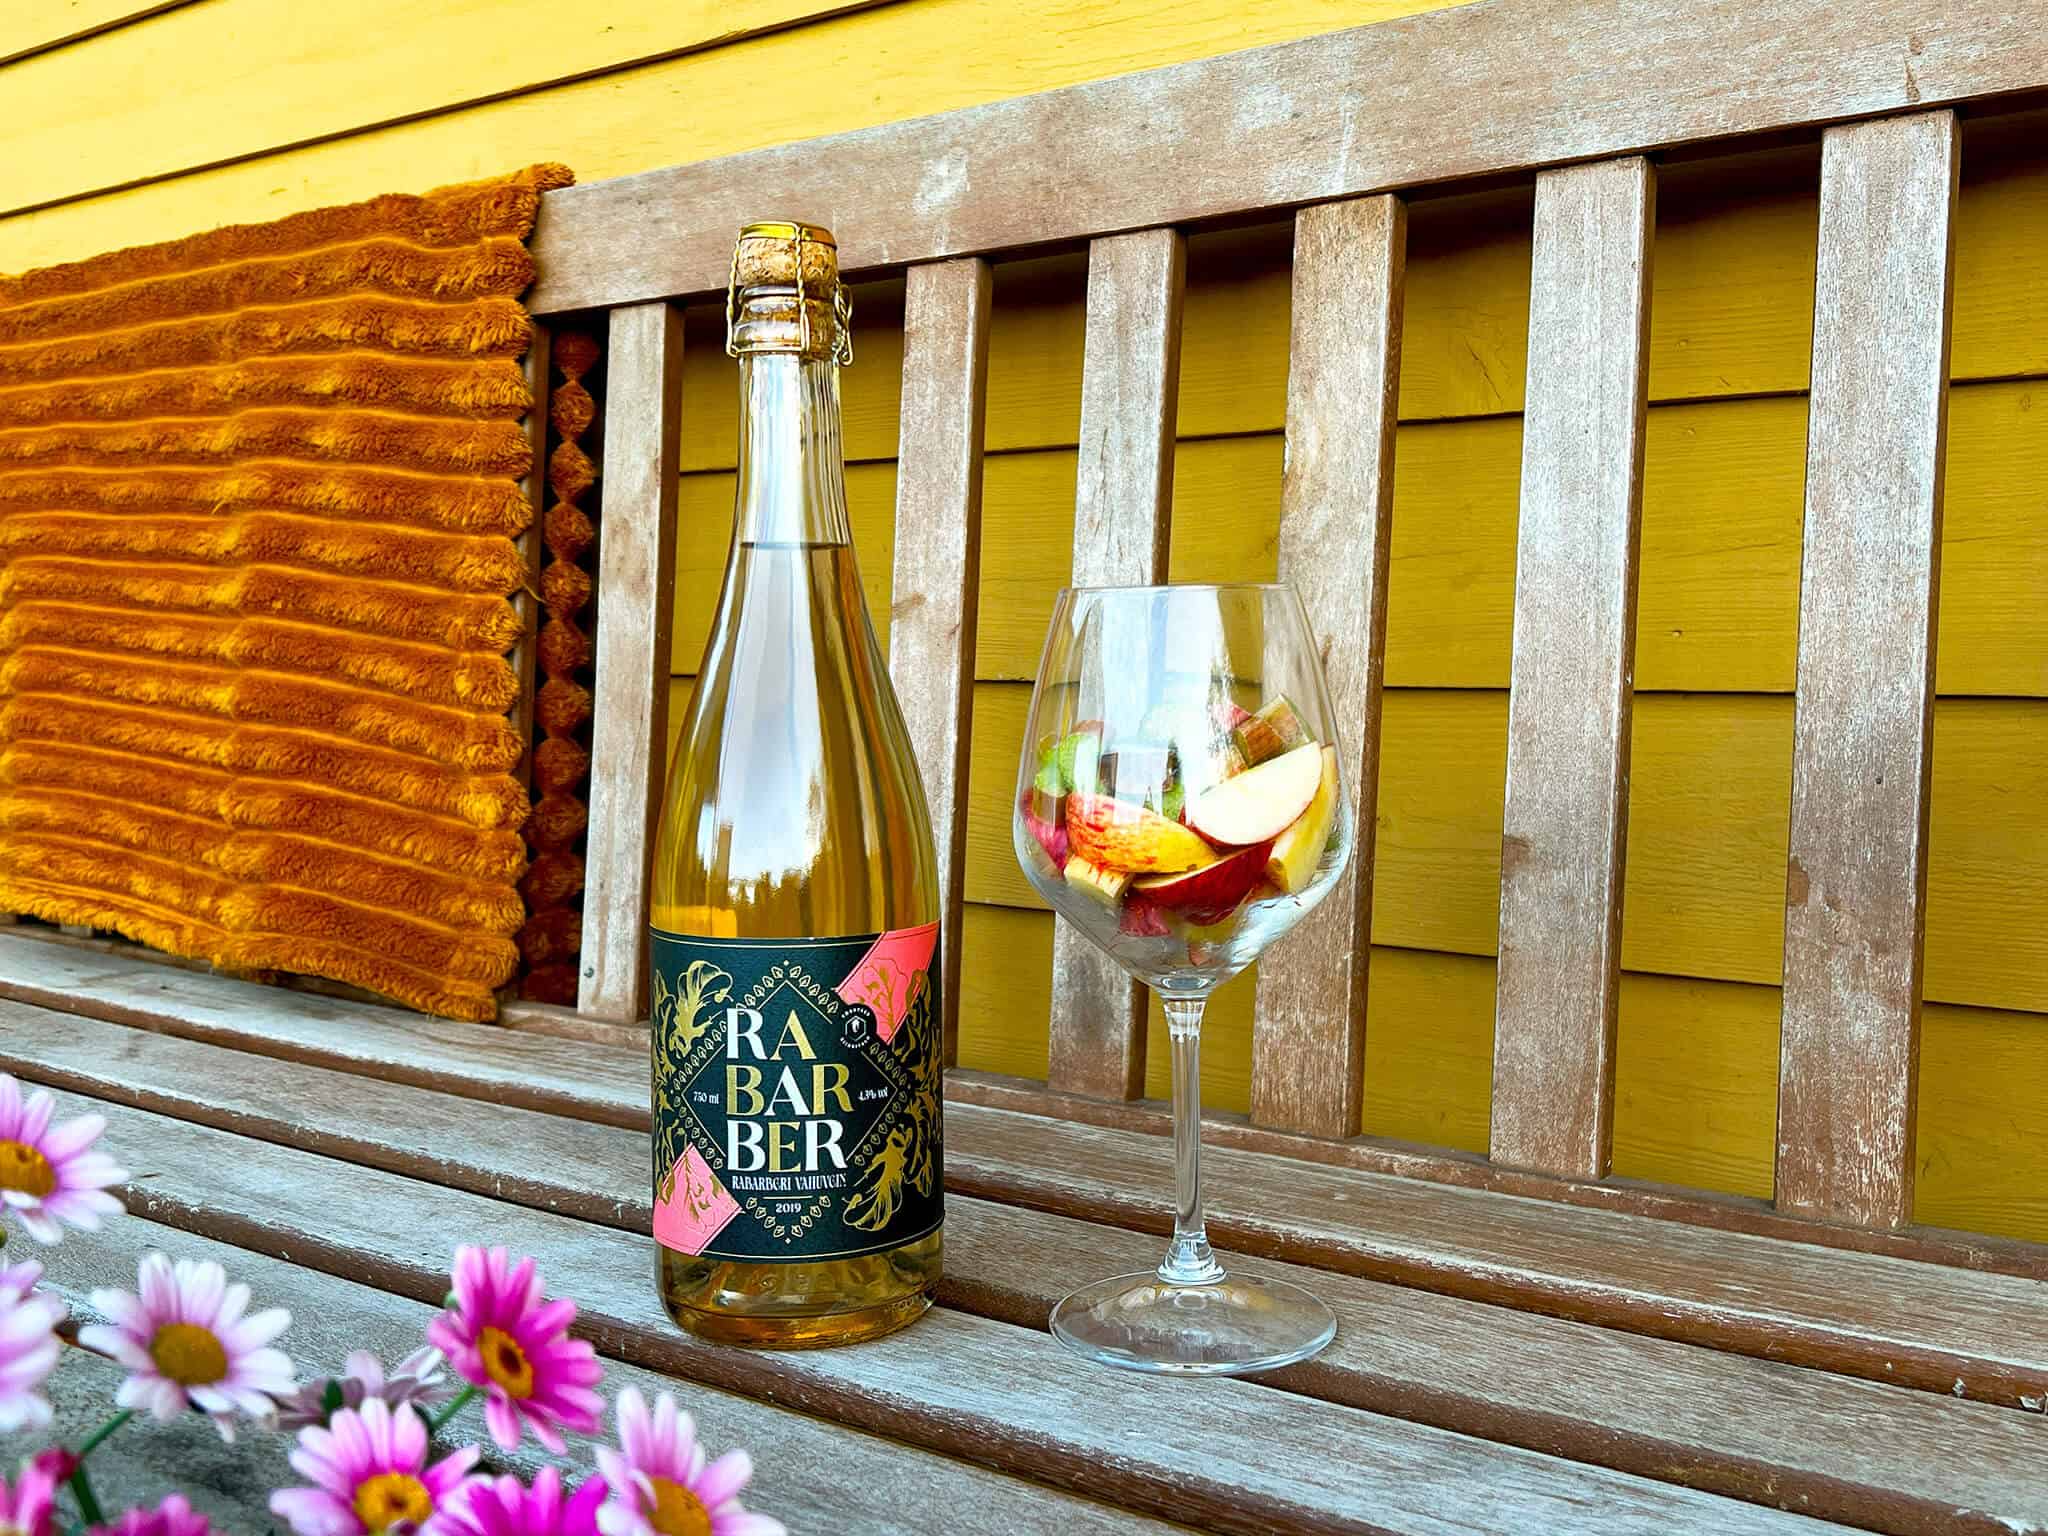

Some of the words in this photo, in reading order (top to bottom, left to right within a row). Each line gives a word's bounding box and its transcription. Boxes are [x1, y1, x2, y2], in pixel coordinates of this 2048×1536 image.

[726, 1007, 817, 1061] RA
[693, 1090, 708, 1103] 750
[708, 1092, 720, 1104] ml
[726, 1063, 854, 1116] BAR
[727, 1119, 849, 1173] BER
[775, 1202, 802, 1214] 2019
